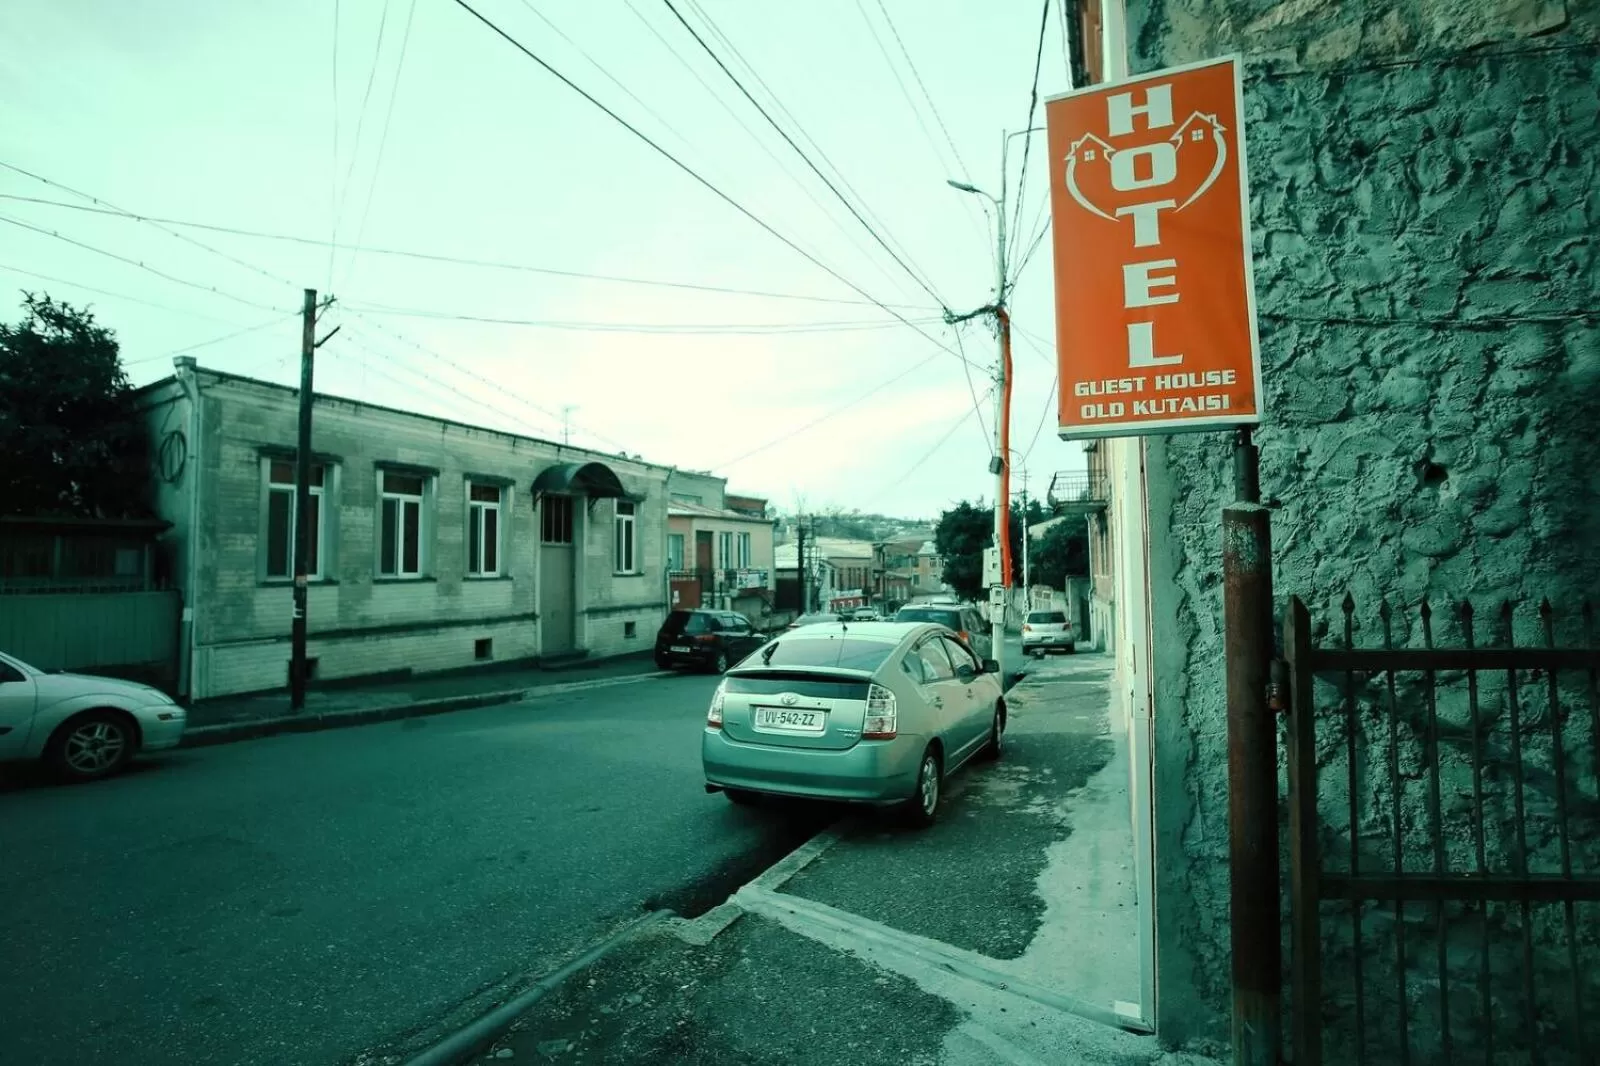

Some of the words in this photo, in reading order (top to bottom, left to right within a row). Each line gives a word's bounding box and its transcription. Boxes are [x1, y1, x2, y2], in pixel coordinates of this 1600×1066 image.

[1107, 83, 1184, 369] HOTEL
[1074, 376, 1147, 397] GUEST
[1155, 369, 1237, 391] HOUSE
[1081, 402, 1125, 420] OLD
[1133, 394, 1230, 416] KUTAISI
